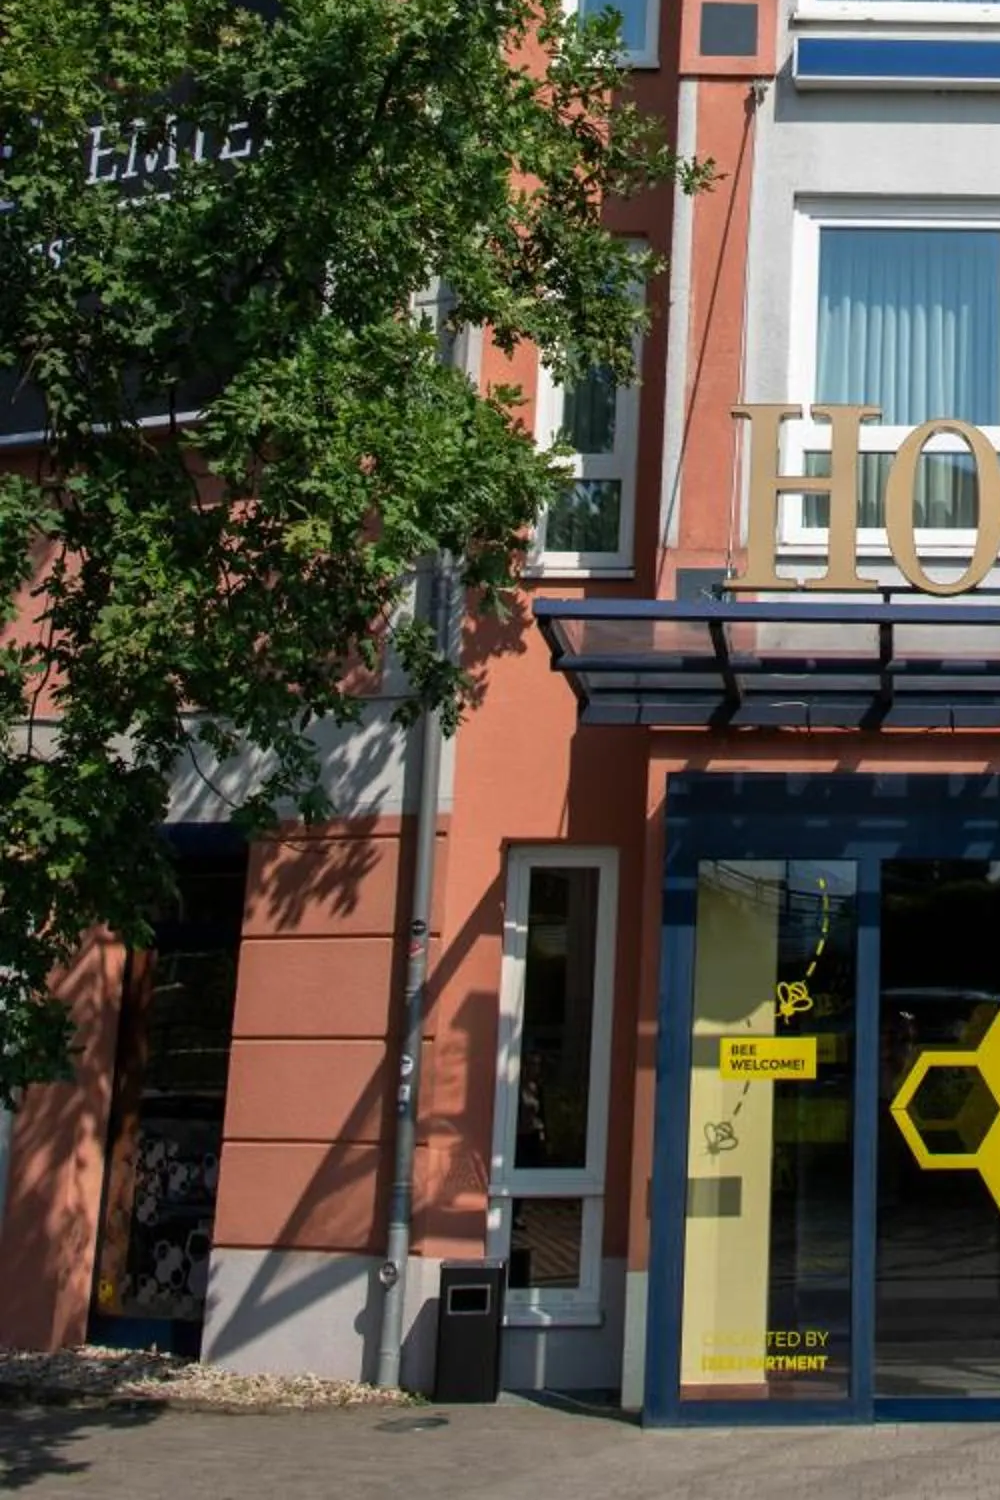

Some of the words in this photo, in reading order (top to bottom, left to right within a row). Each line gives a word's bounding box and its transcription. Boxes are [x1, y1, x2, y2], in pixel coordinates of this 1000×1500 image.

[730, 1043, 758, 1056] BEE
[729, 1059, 806, 1072] WELCOME!
[804, 1331, 829, 1347] BY
